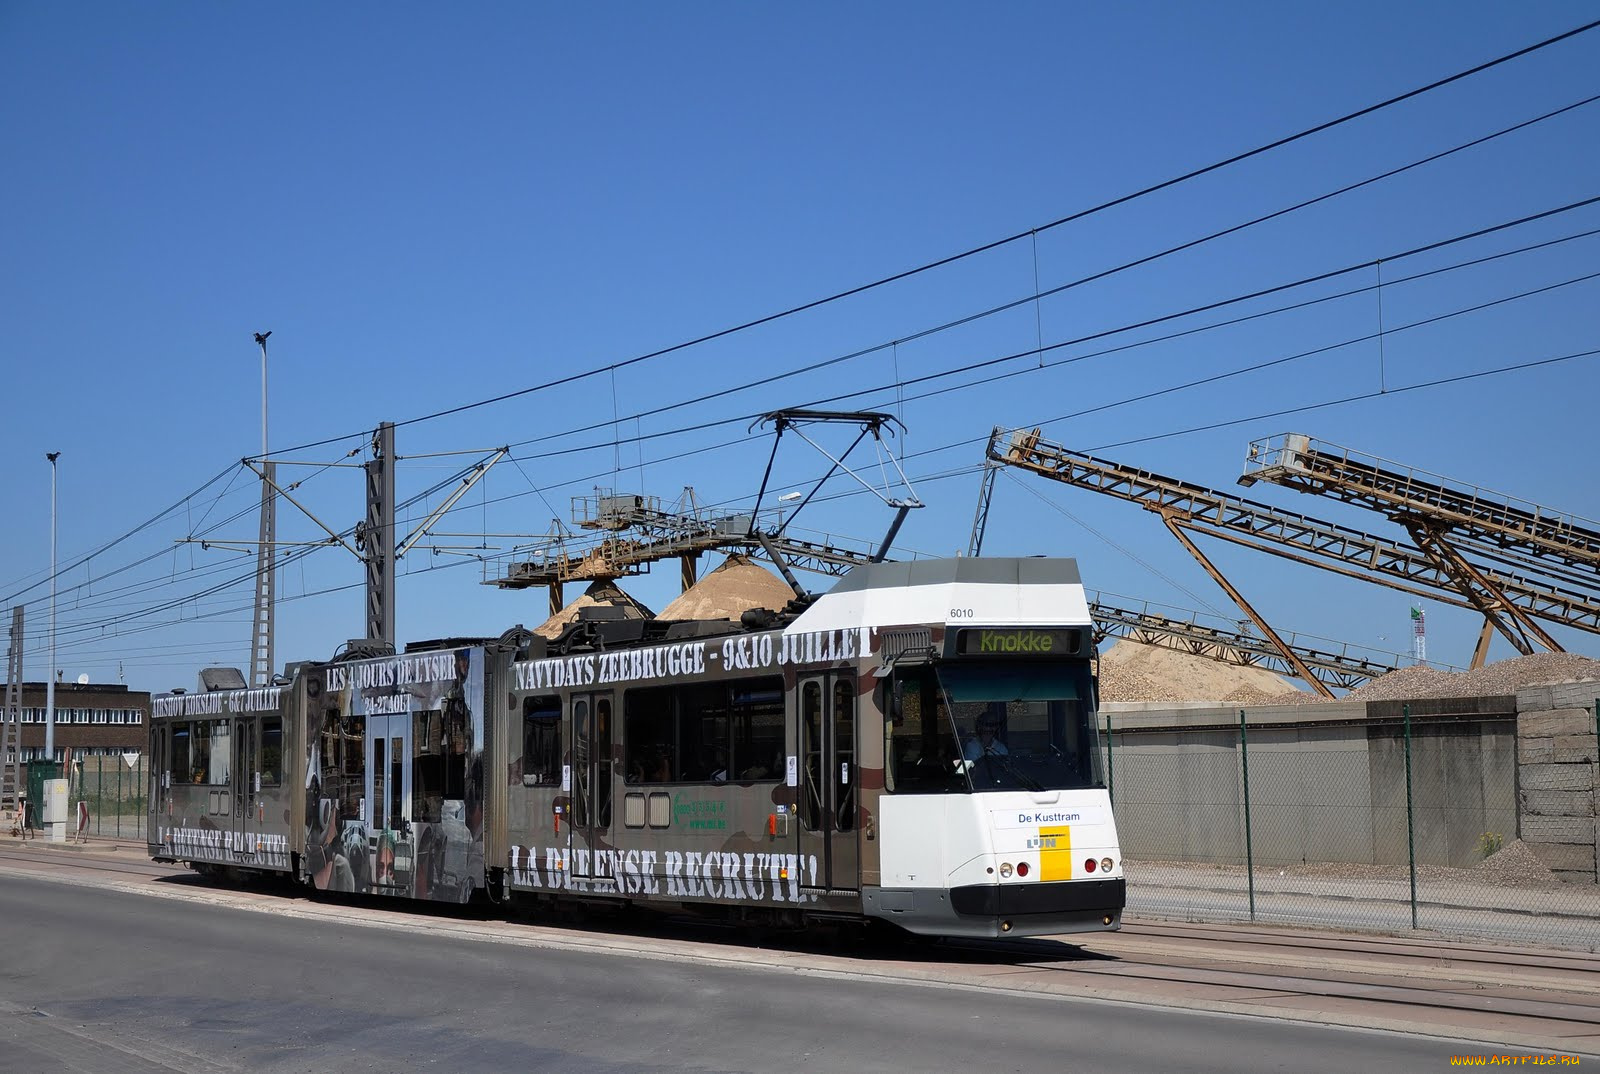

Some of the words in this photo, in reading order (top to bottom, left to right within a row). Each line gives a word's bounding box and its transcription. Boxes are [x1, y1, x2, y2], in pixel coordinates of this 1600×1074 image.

[950, 608, 974, 618] 6010
[980, 630, 1053, 652] Knokke
[326, 668, 346, 692] LES
[348, 666, 355, 690] 4
[356, 662, 395, 689] JOURS
[396, 659, 413, 686] DE
[414, 654, 458, 684] L'YSER
[514, 657, 595, 691] NAVYDAYS
[598, 643, 706, 683] ZEEBRUGGE
[777, 626, 878, 666] JUILLET
[151, 696, 184, 718] AIRSHOW
[184, 693, 224, 716] KOKSIJDE
[228, 691, 245, 713] 6&7
[245, 688, 282, 712] JUILLET
[1018, 814, 1032, 823] De
[1035, 812, 1080, 823] Kusttram
[511, 845, 543, 888] LA
